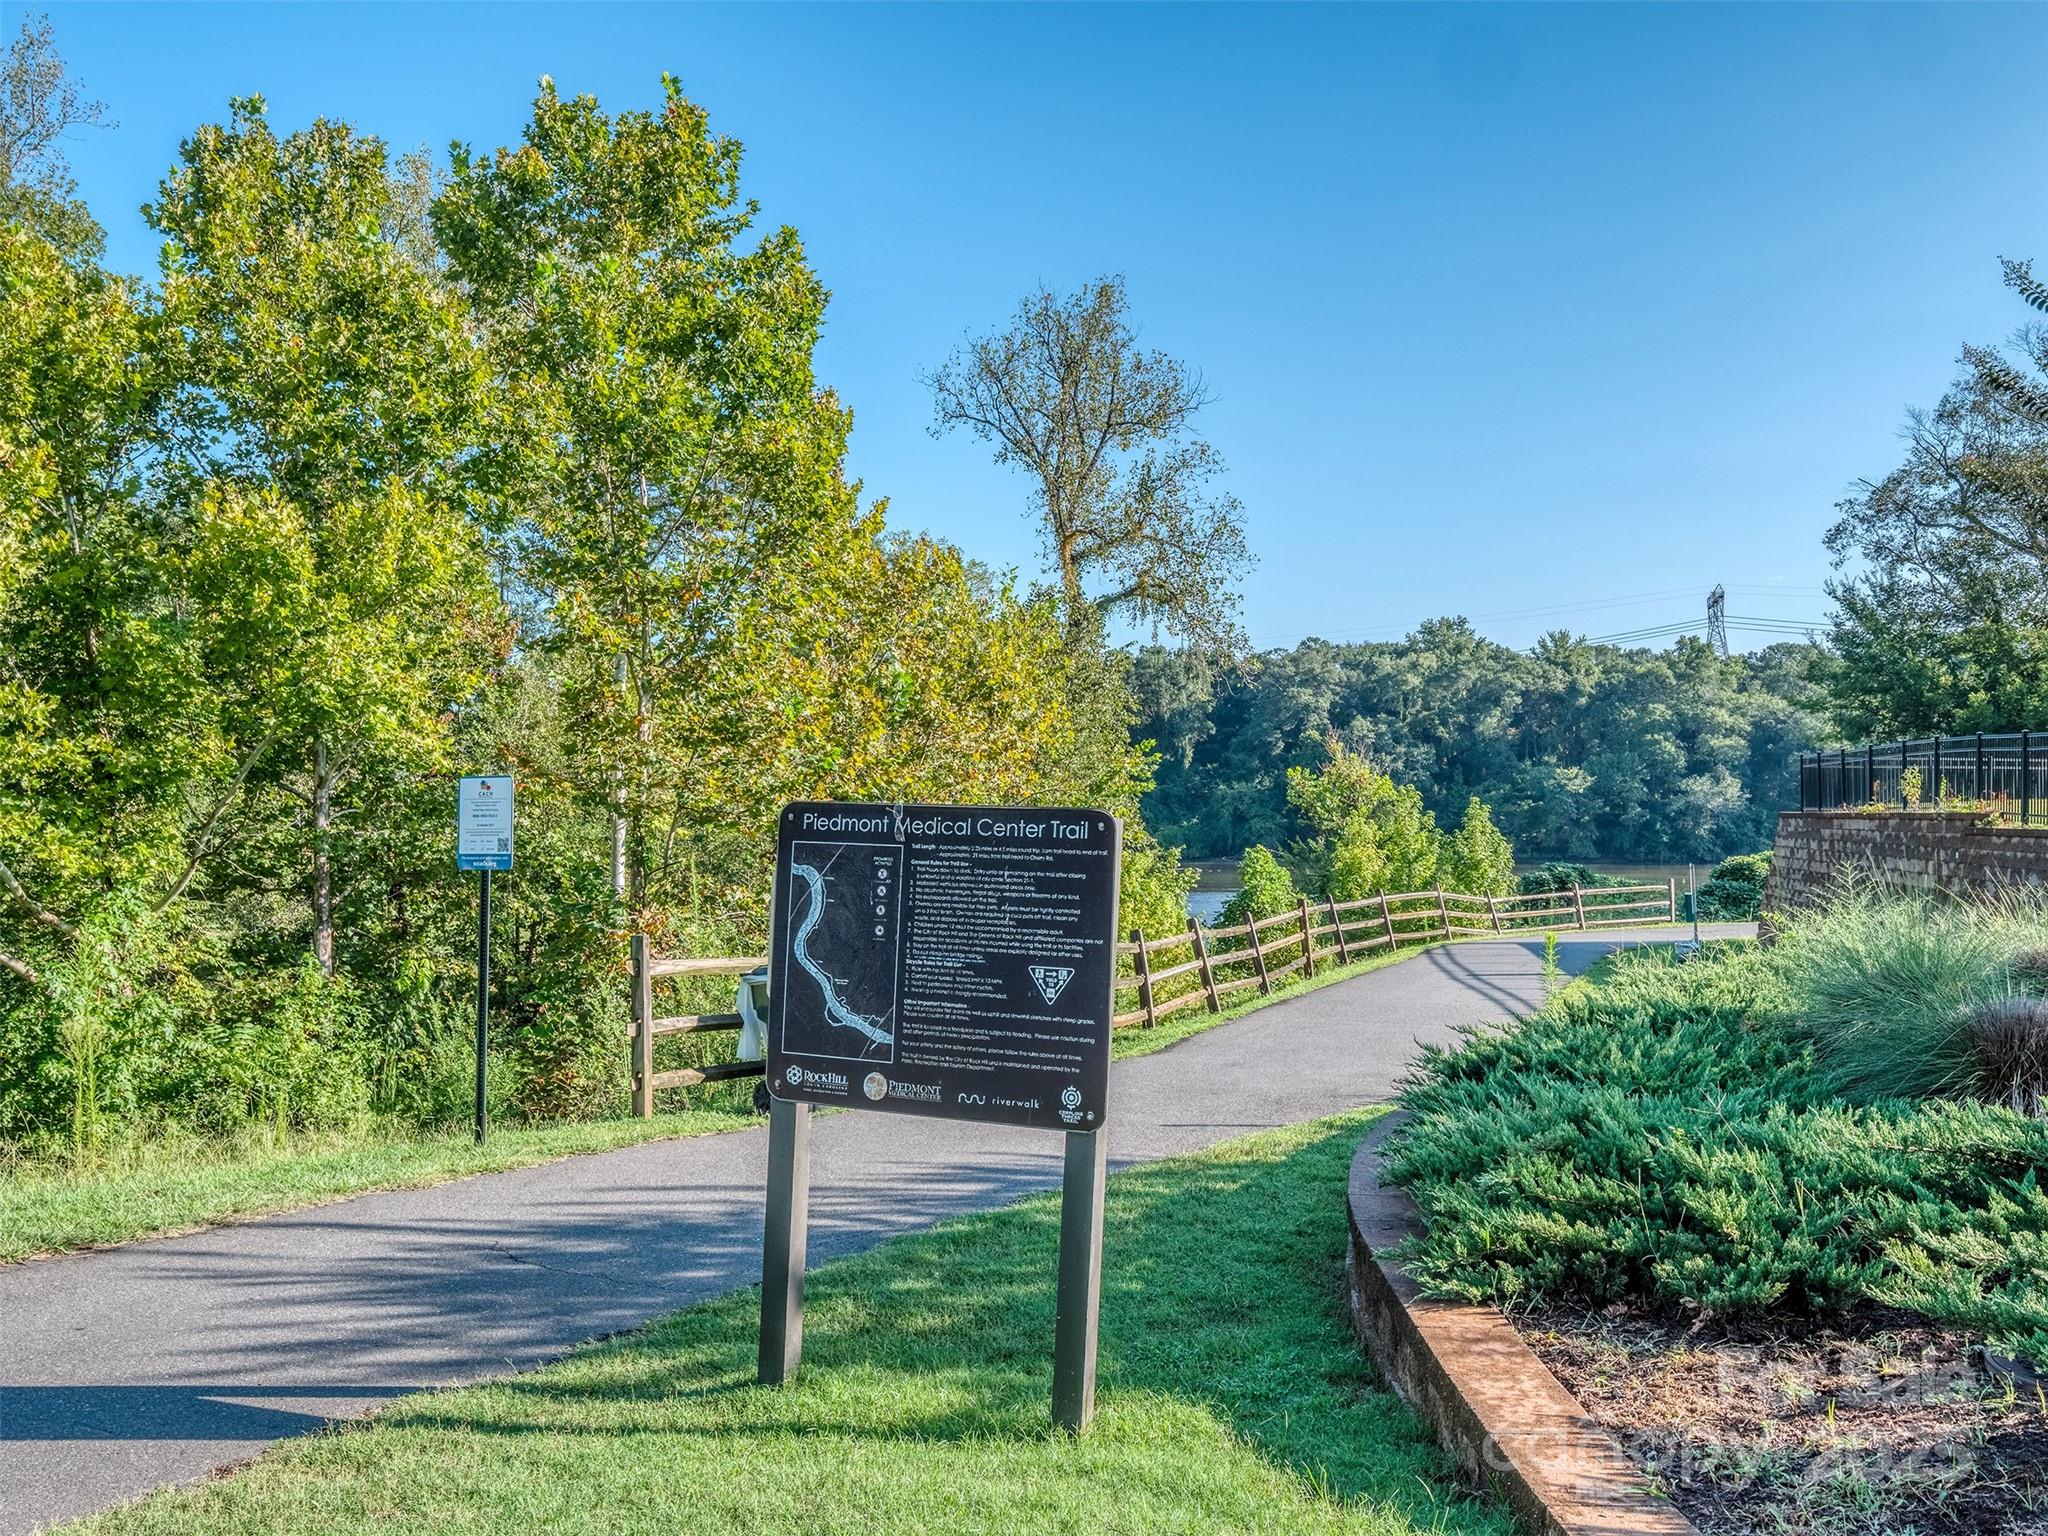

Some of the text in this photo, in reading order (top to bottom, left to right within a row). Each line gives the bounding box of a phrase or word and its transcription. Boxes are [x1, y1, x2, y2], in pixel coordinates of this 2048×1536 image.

[803, 812, 1088, 840] Piedmont Medical Center Trail
[889, 1079, 942, 1095] PIEDMONT
[992, 1095, 1040, 1109] riverwalk
